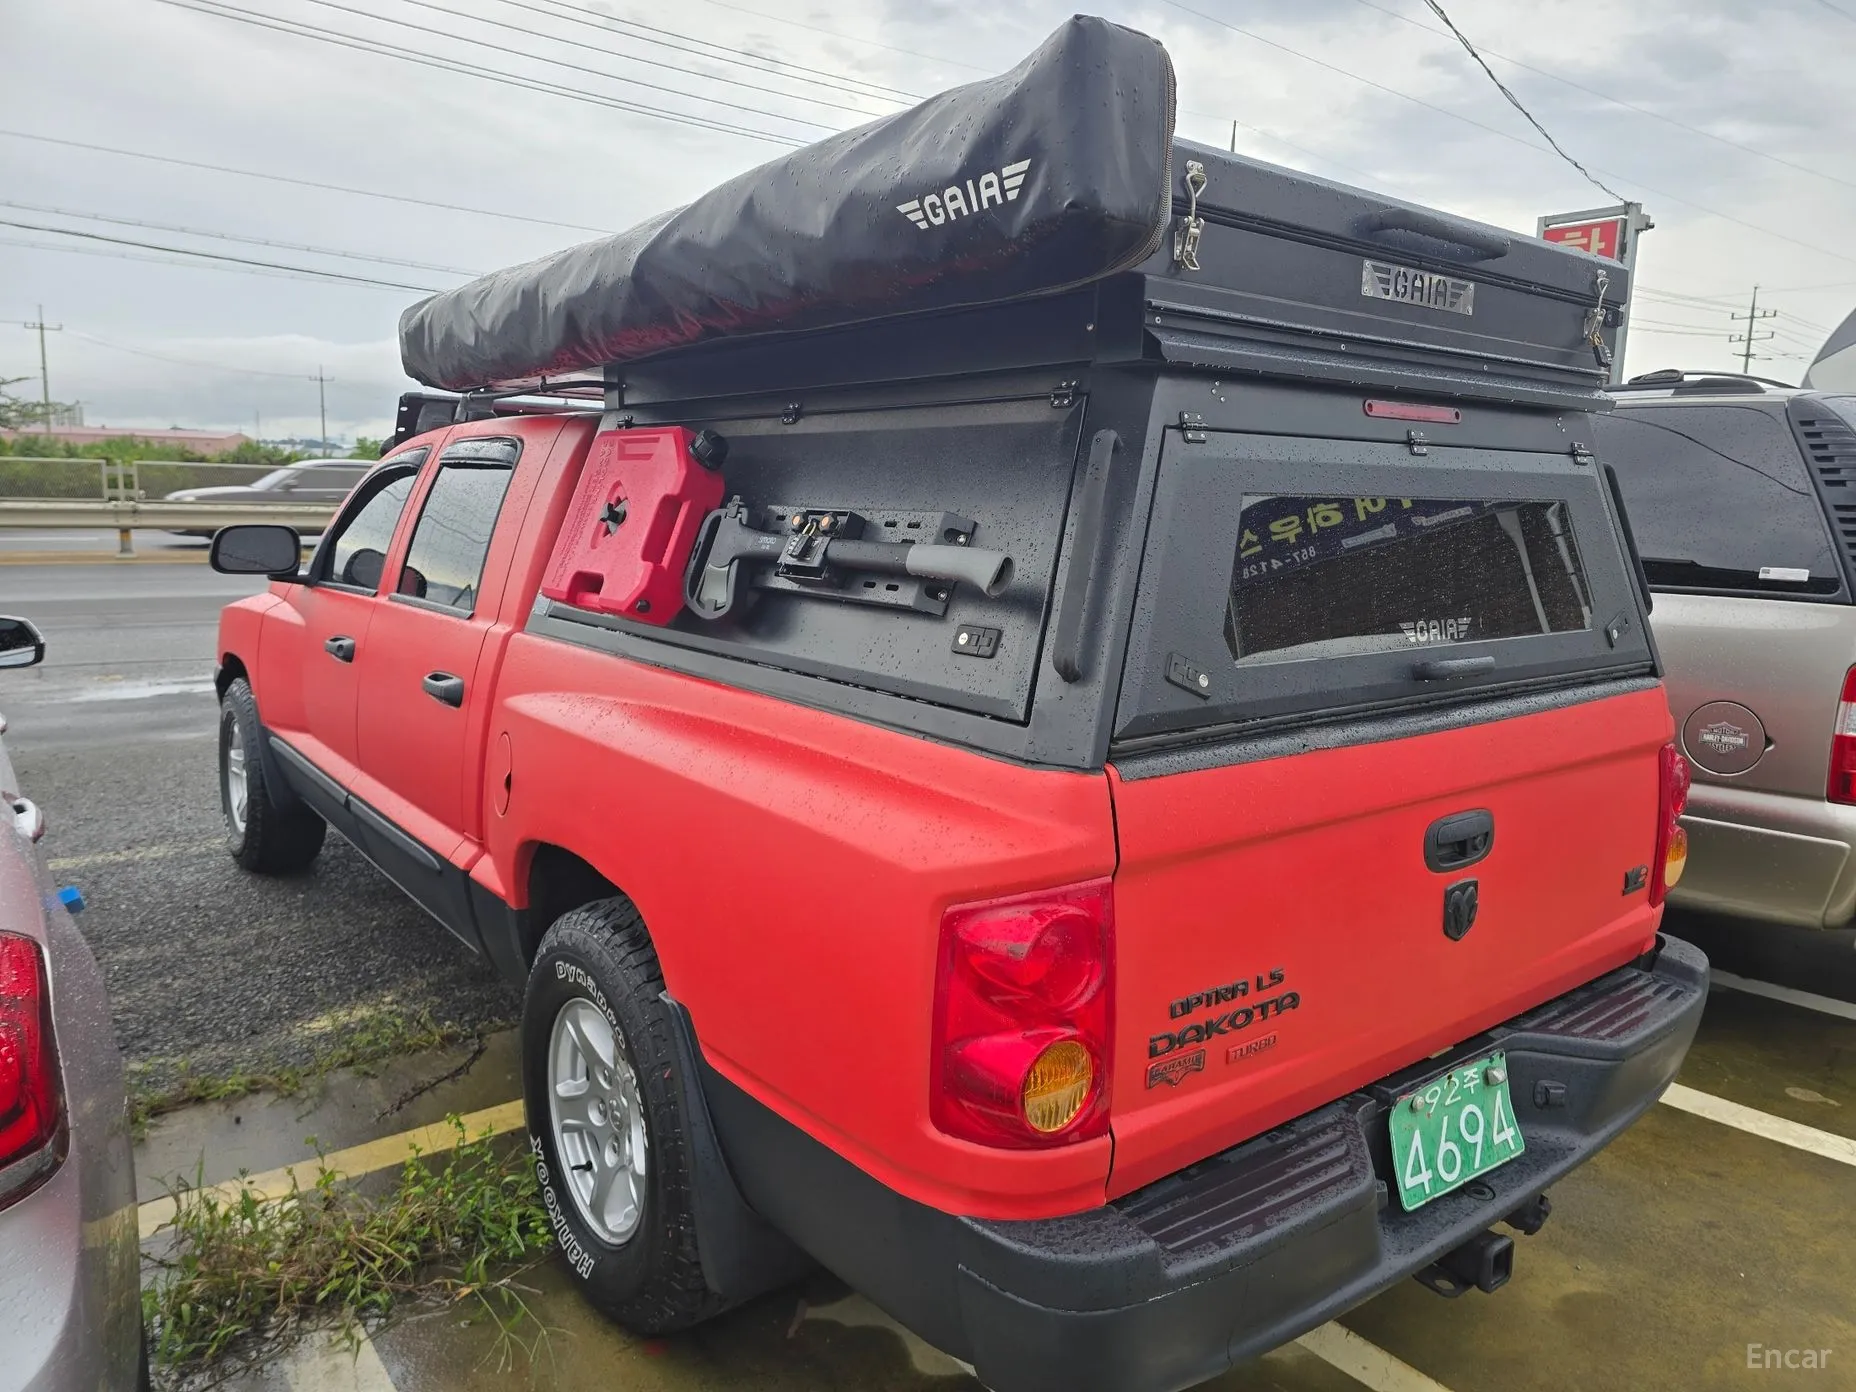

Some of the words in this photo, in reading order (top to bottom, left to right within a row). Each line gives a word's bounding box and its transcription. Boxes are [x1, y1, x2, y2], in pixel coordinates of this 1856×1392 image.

[1169, 979, 1249, 1020] OPTRA
[1256, 967, 1285, 992] LS
[1148, 992, 1300, 1059] DAKOTA
[1231, 1035, 1277, 1060] TURBO
[1424, 1068, 1479, 1115] 92주
[1404, 1090, 1515, 1194] 4694
